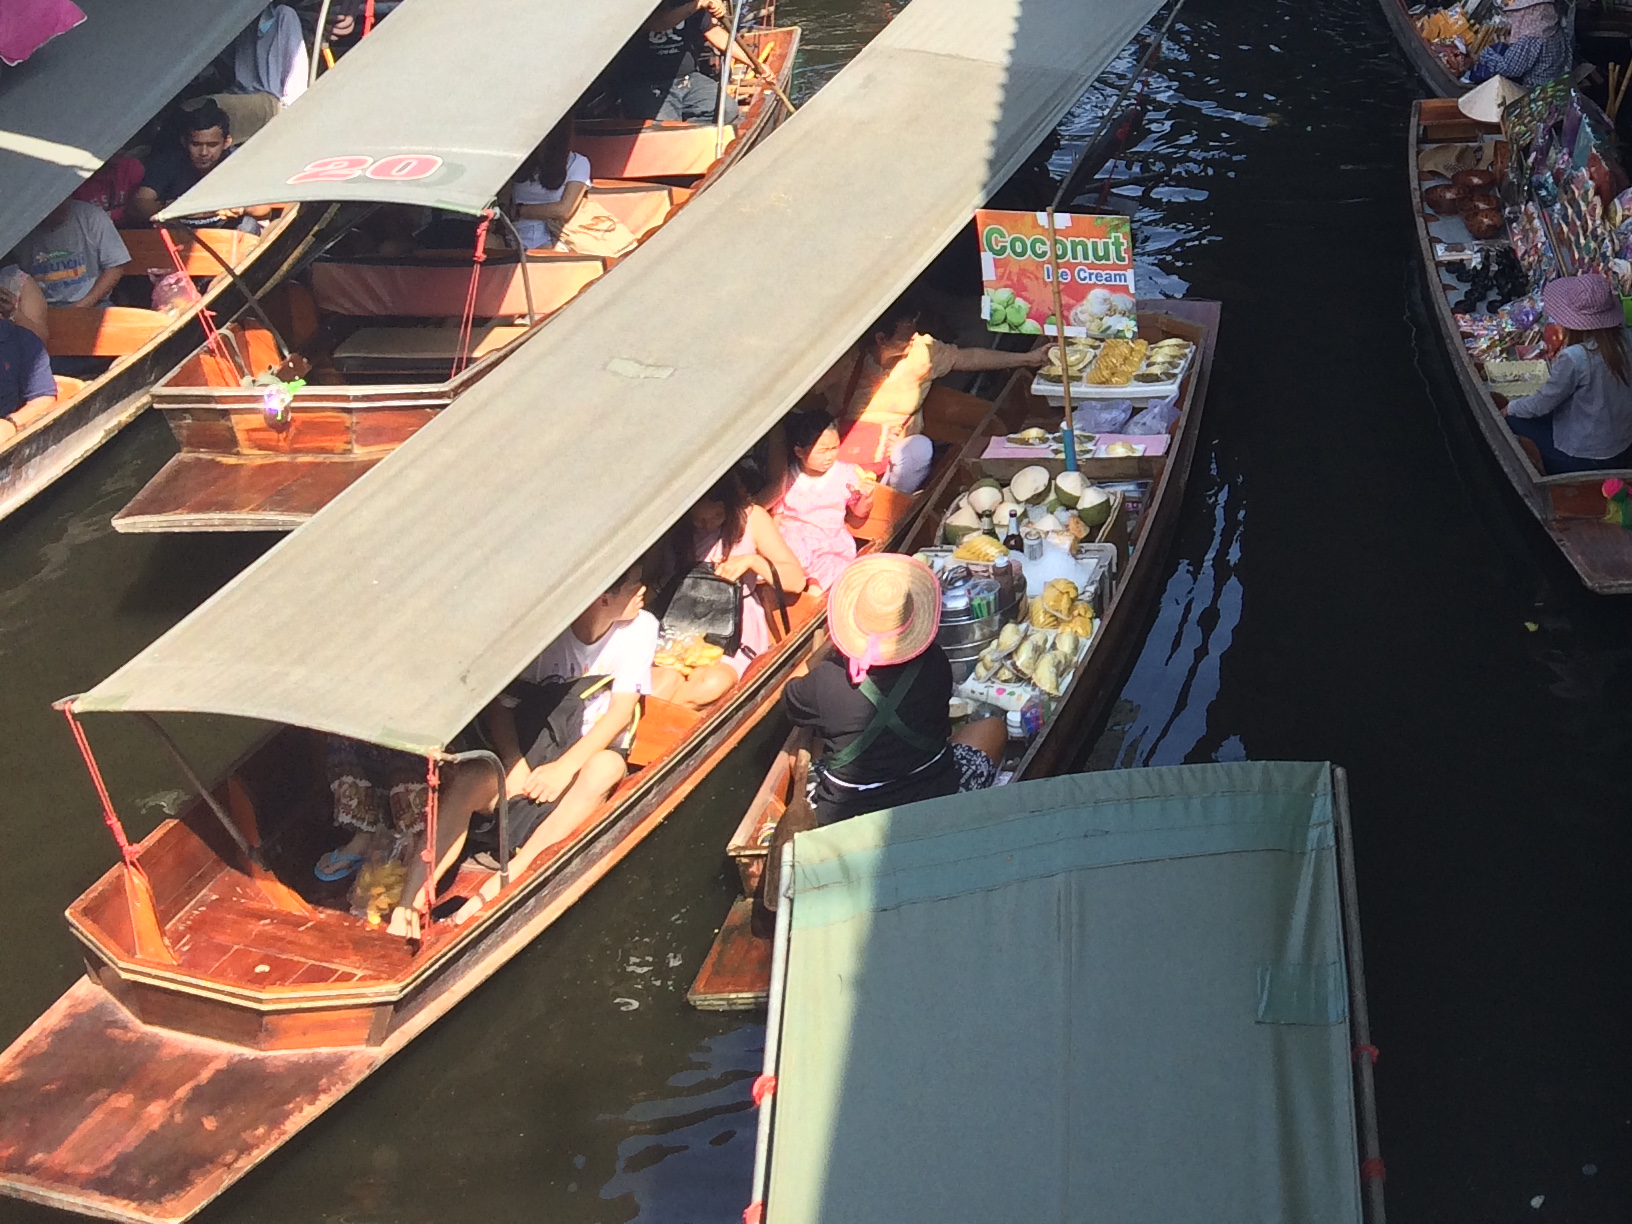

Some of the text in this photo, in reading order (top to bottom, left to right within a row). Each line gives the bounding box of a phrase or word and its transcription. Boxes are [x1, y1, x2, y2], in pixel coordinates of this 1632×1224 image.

[286, 154, 443, 184] 20
[983, 226, 1127, 264] Coconut
[1045, 266, 1127, 283] Ie Cream
